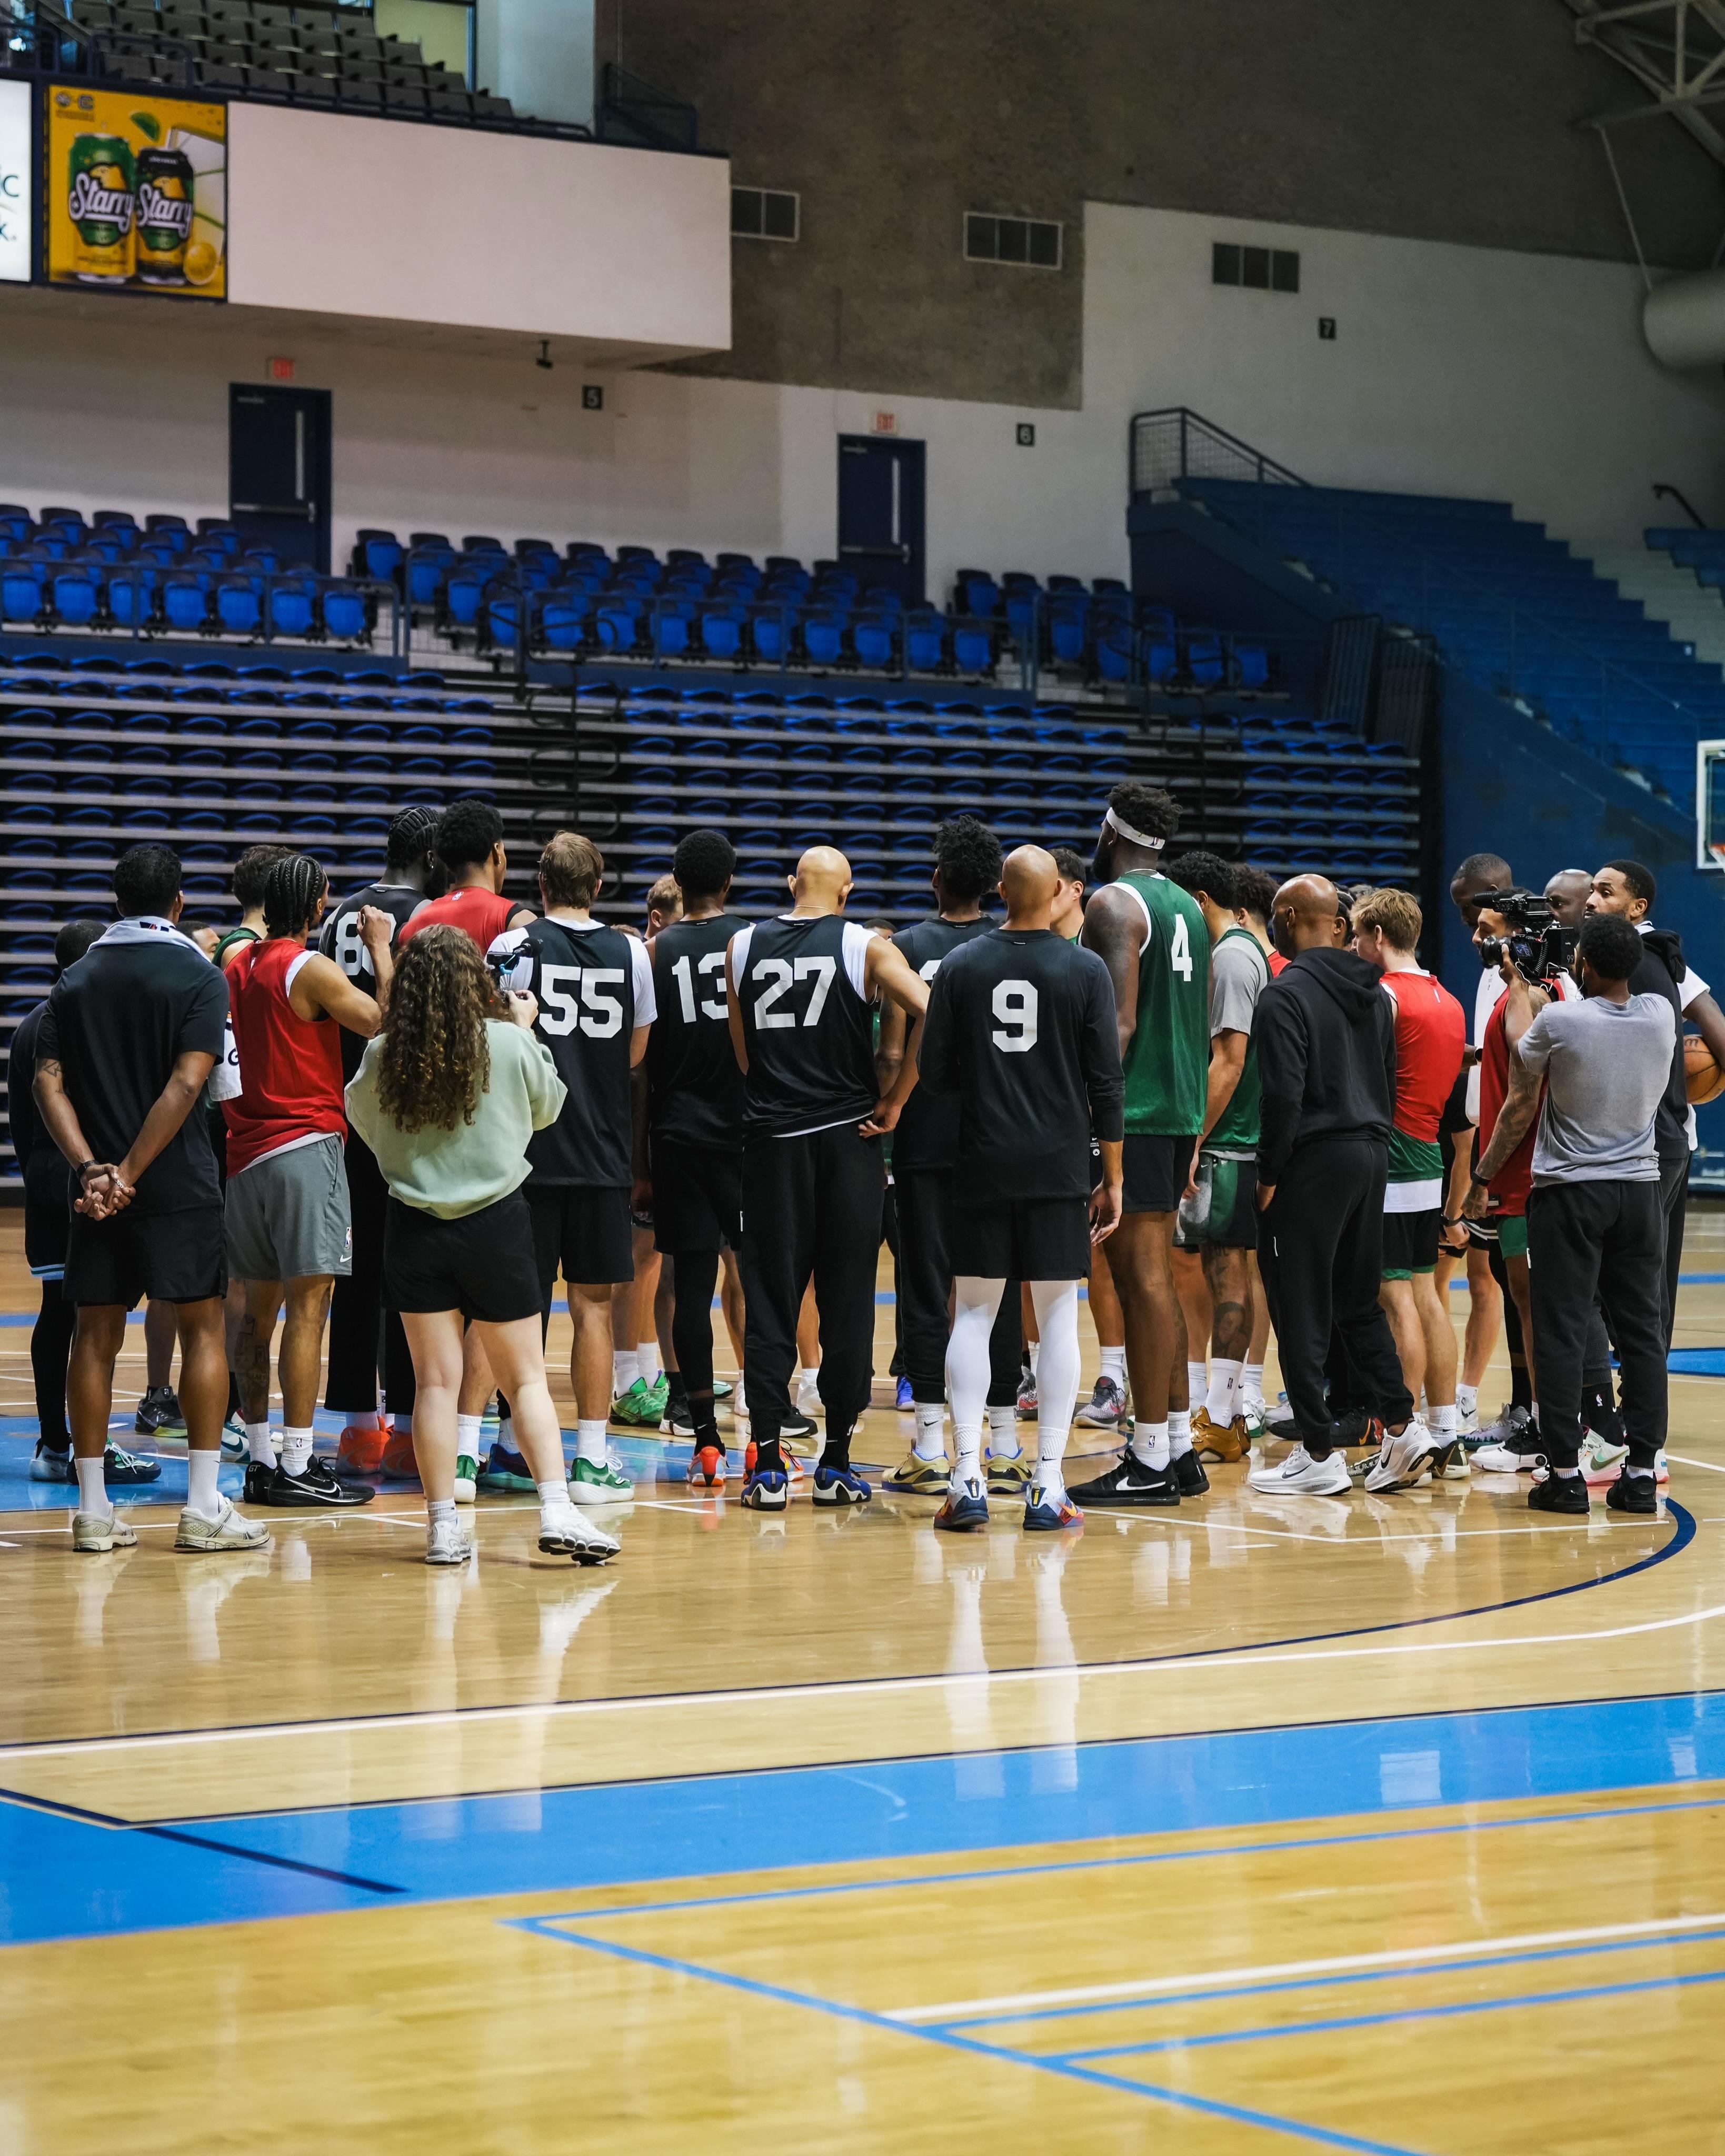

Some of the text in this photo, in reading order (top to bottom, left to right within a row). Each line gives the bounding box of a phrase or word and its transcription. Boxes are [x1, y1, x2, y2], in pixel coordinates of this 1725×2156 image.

[69, 172, 134, 233] Starry
[1172, 914, 1193, 982] 4
[539, 964, 625, 1038] 55
[671, 952, 729, 1023] 13
[752, 956, 837, 1030] 27
[992, 980, 1038, 1052] 9
